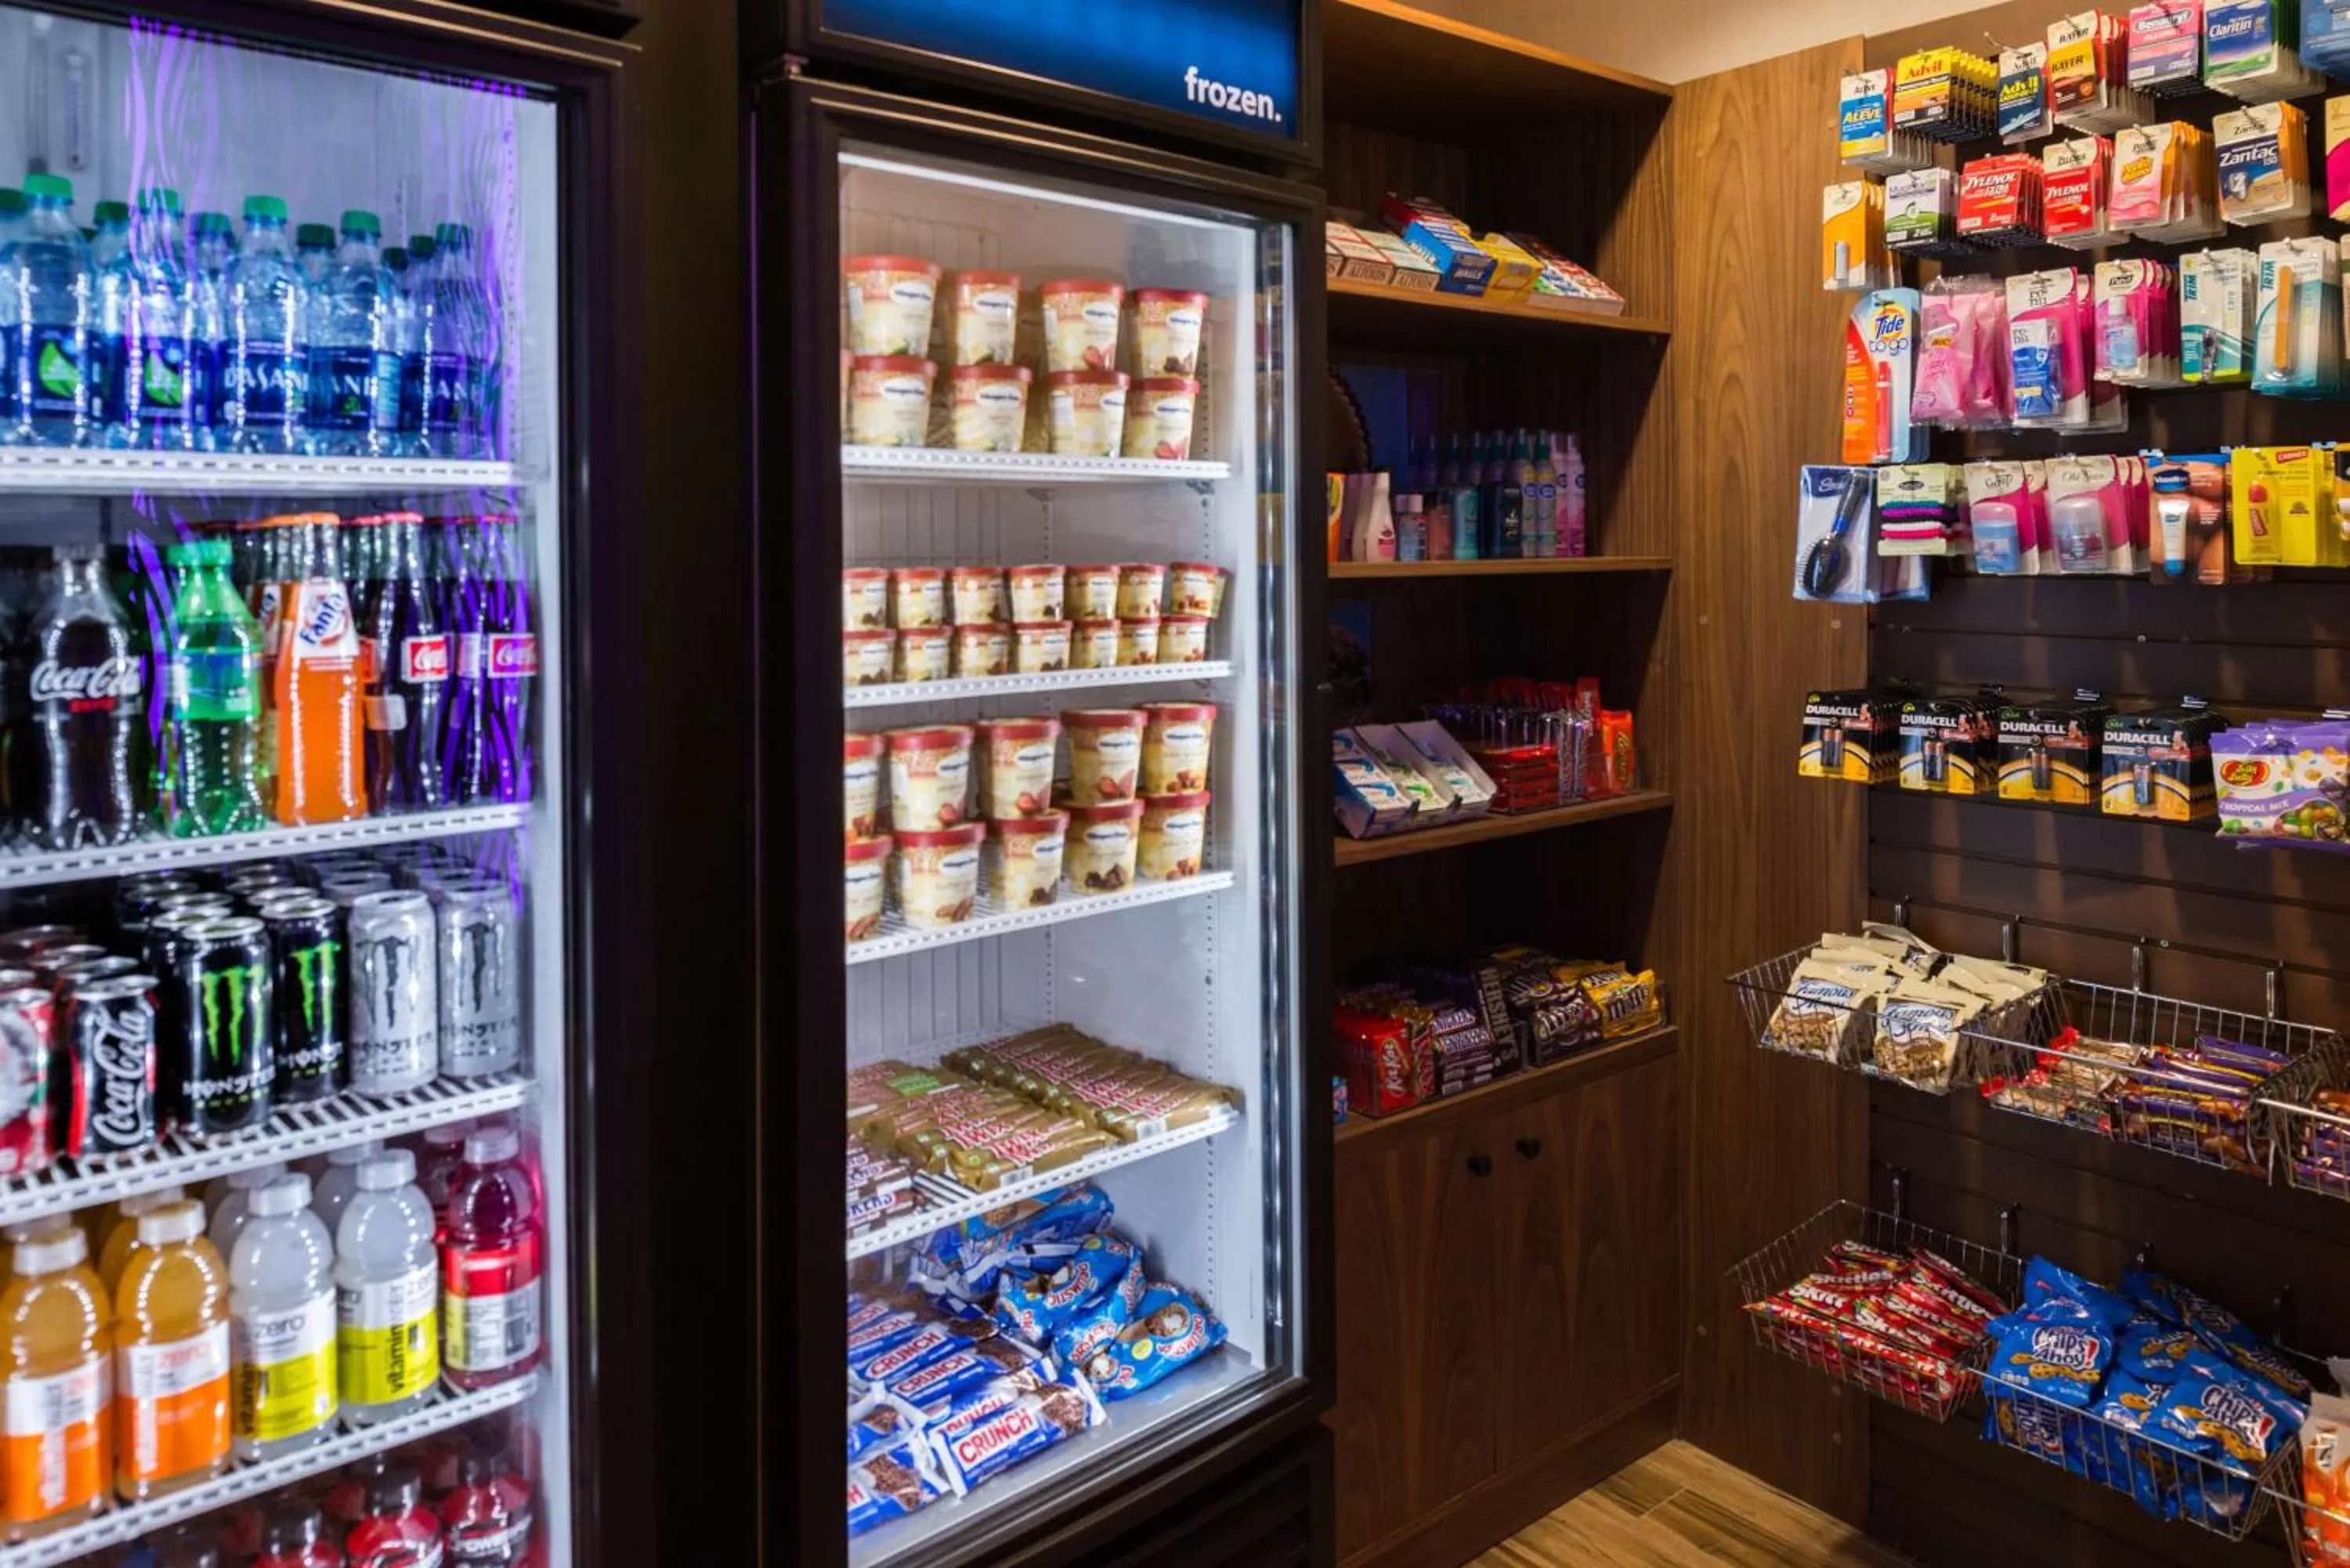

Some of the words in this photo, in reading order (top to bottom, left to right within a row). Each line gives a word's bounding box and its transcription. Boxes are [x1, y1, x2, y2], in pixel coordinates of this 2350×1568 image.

[2209, 19, 2253, 38] Claritin
[1907, 60, 1943, 79] Advil
[2052, 56, 2084, 72] BAYER
[1184, 67, 1282, 122] frozen.
[2000, 75, 2038, 95] Advil
[1842, 107, 1881, 123] ALEVE
[2218, 146, 2277, 167] Zantac
[1966, 172, 2016, 189] TYLENOL
[2046, 182, 2089, 198] TYLENOL
[2261, 261, 2276, 291] TRIM
[2184, 274, 2197, 302] TRIM
[1875, 315, 1905, 338] Tide
[299, 591, 345, 646] Fanta
[1806, 704, 1858, 717] DURACELL
[1901, 714, 1957, 727] DURACELL
[2000, 721, 2066, 734] DURACELL
[2103, 731, 2171, 745] DURACELL
[2219, 801, 2266, 813] TROPICAL
[1479, 967, 1519, 1061] HERSHEY'S
[1883, 1004, 1955, 1021] Famous
[92, 1003, 148, 1147] Coca-Cola
[2033, 1327, 2087, 1353] Chips
[385, 1323, 404, 1393] vitamin
[870, 1331, 941, 1375] CRUNCH
[897, 1353, 971, 1392] CRUNCH
[2203, 1385, 2258, 1424] Chips
[957, 1407, 1034, 1465] CRUNCH
